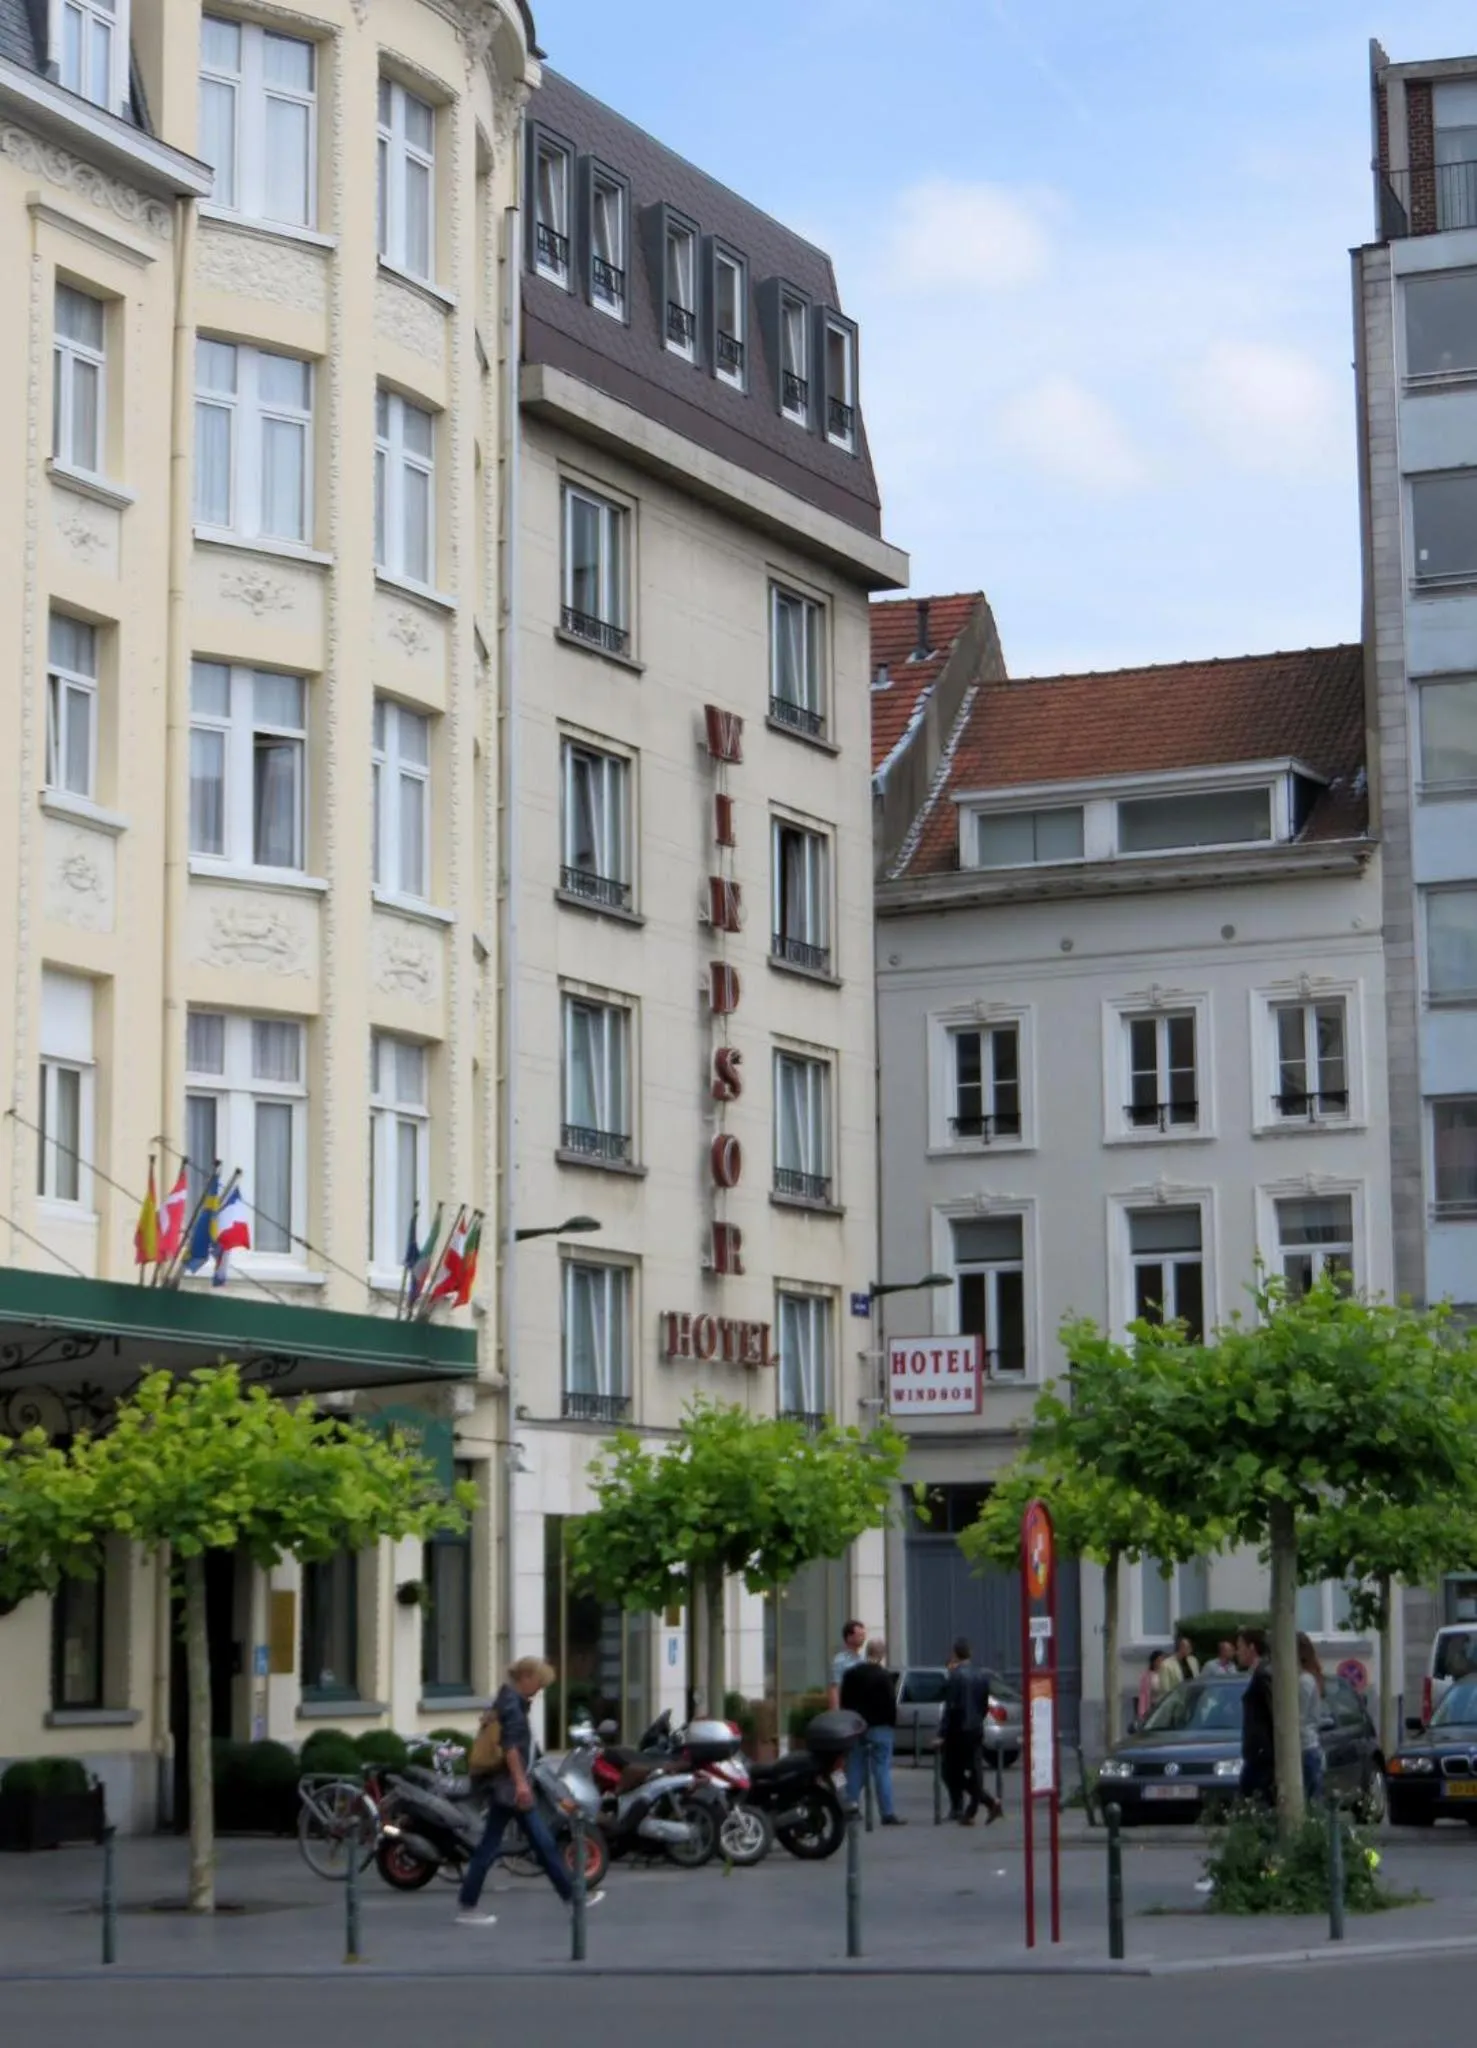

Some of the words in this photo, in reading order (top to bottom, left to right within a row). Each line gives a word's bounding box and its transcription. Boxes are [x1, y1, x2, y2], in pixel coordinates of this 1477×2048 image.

[704, 704, 744, 1275] WINDSOR
[664, 1311, 779, 1367] HOTEL
[891, 1350, 974, 1375] HOTEL
[893, 1387, 973, 1402] WINDSOR
